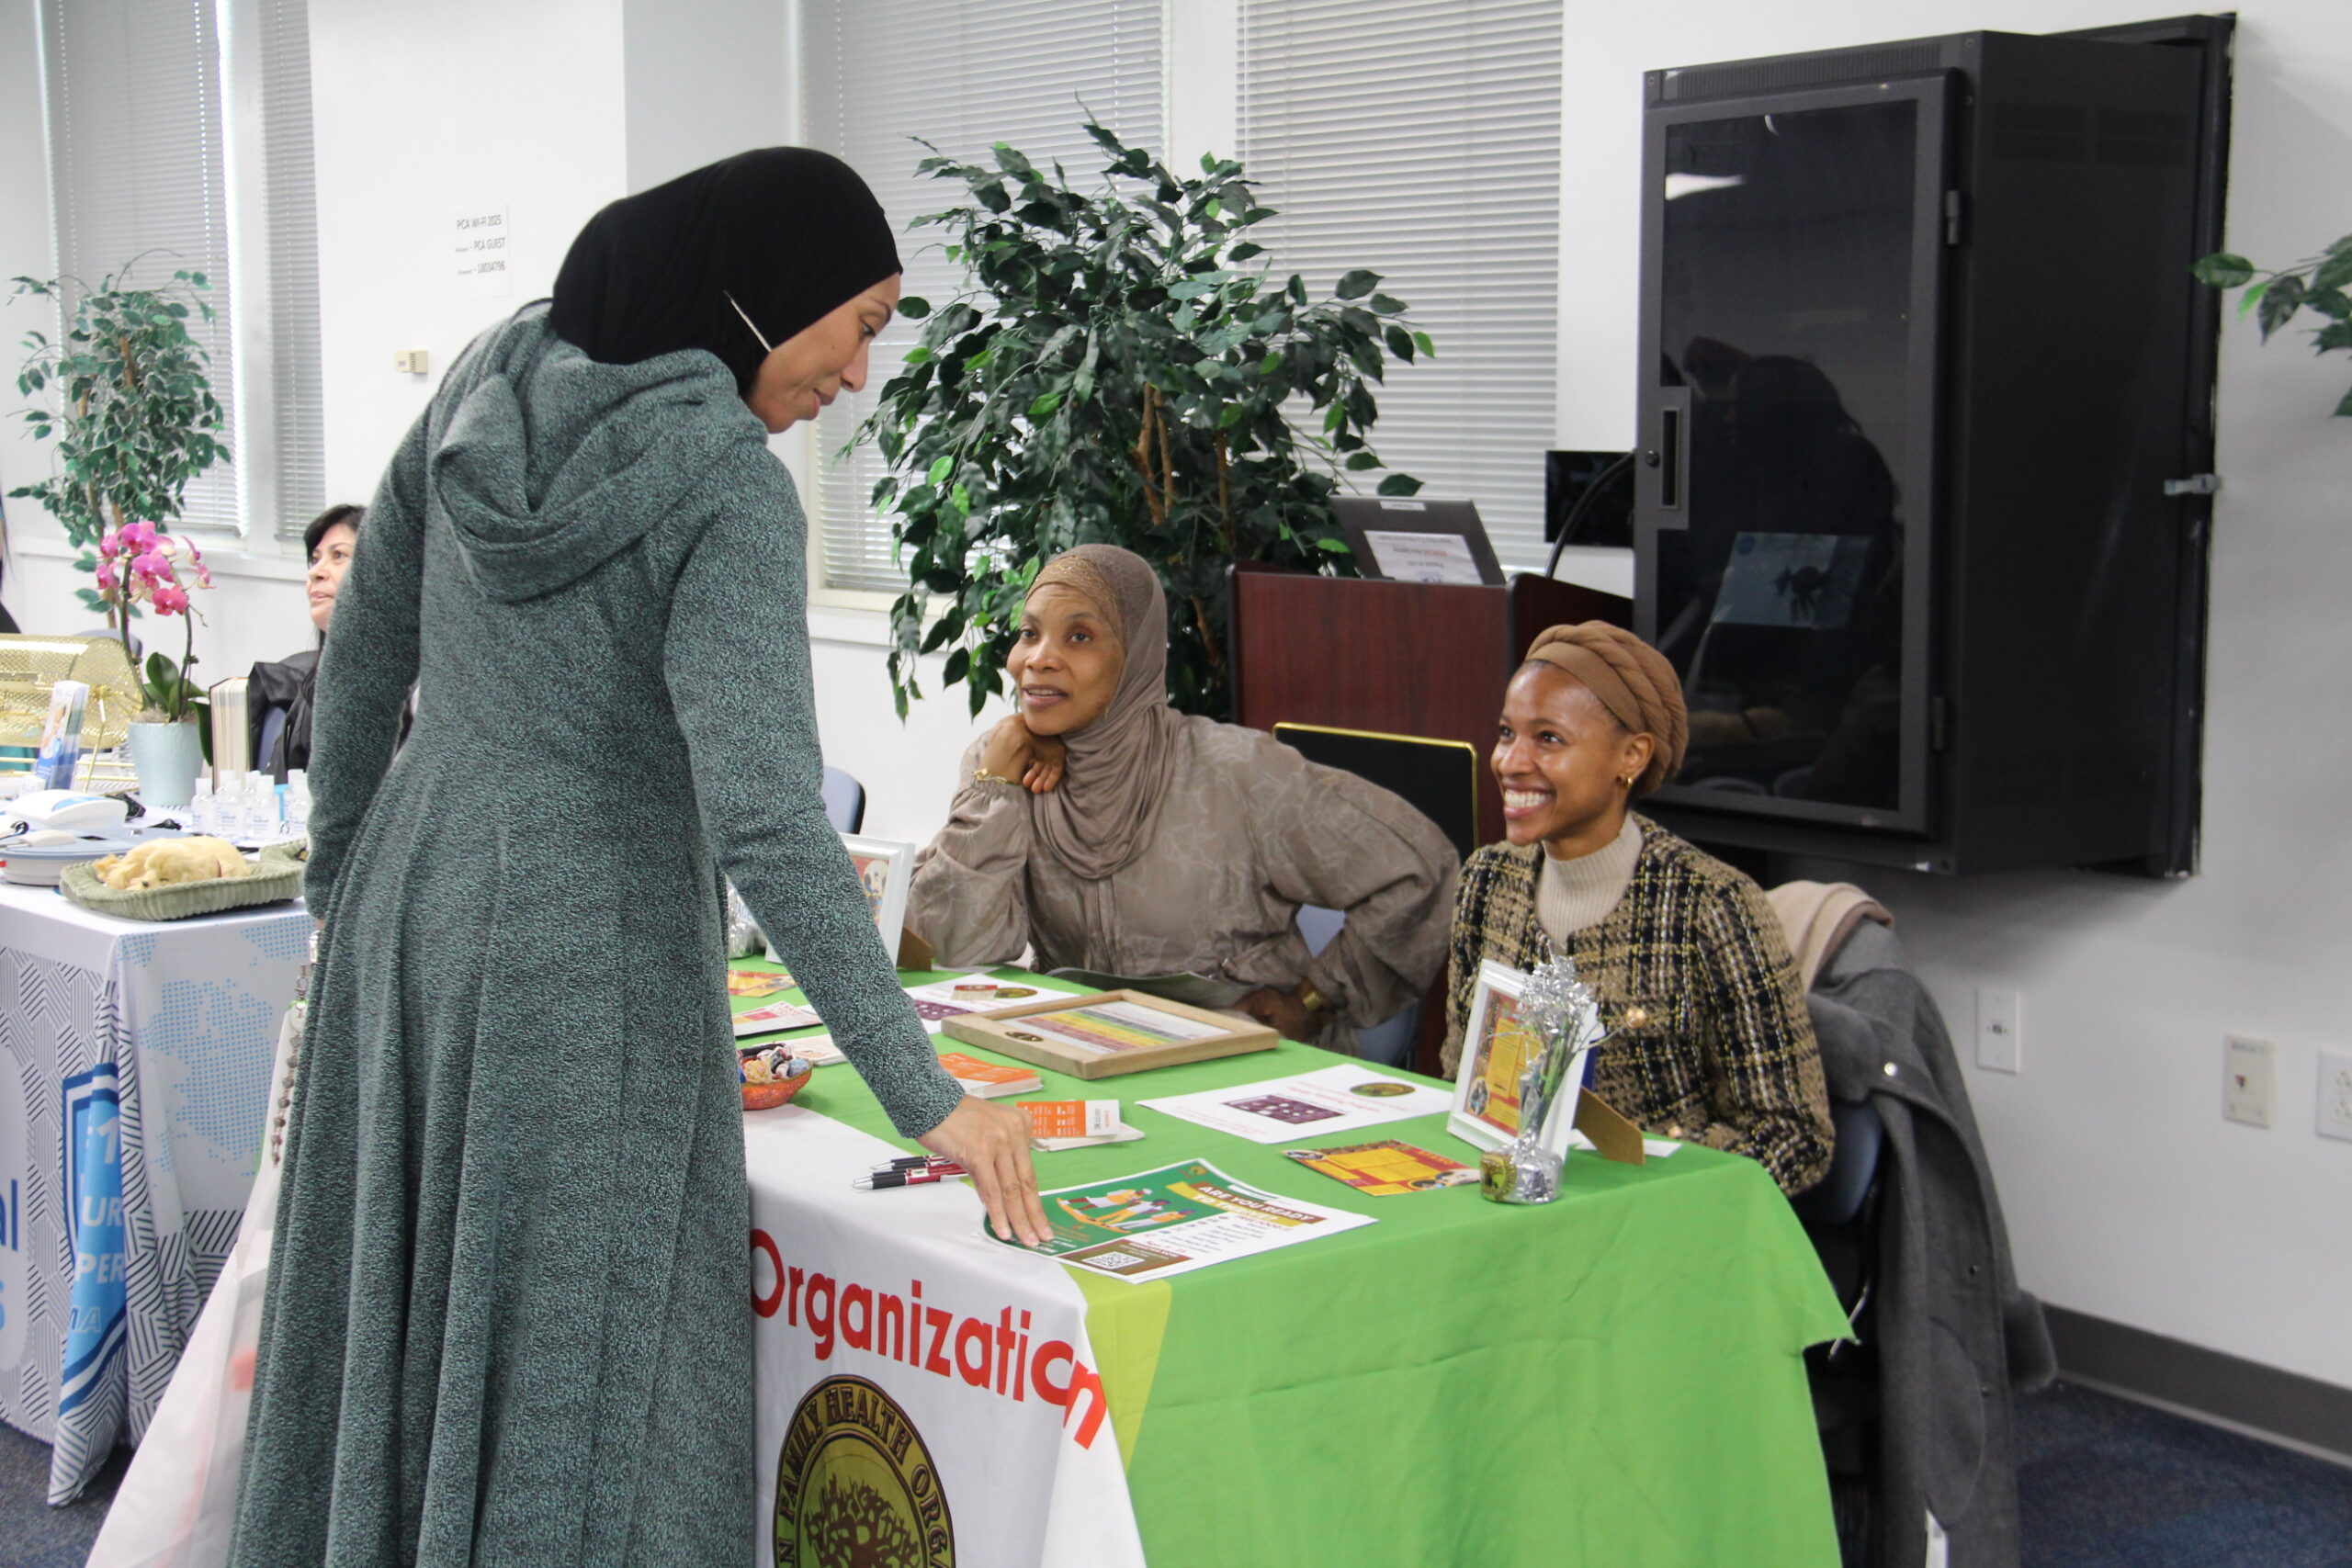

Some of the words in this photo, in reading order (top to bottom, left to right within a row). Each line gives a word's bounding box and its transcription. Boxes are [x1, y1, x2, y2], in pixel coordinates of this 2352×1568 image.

[1192, 1193, 1216, 1204] TO
[1198, 1186, 1232, 1200] ARE
[1231, 1196, 1265, 1210] YOU
[1261, 1206, 1315, 1221] READY
[751, 1228, 1107, 1450] Organization
[779, 1399, 824, 1526] FAMILY
[824, 1385, 912, 1466] HEALTH
